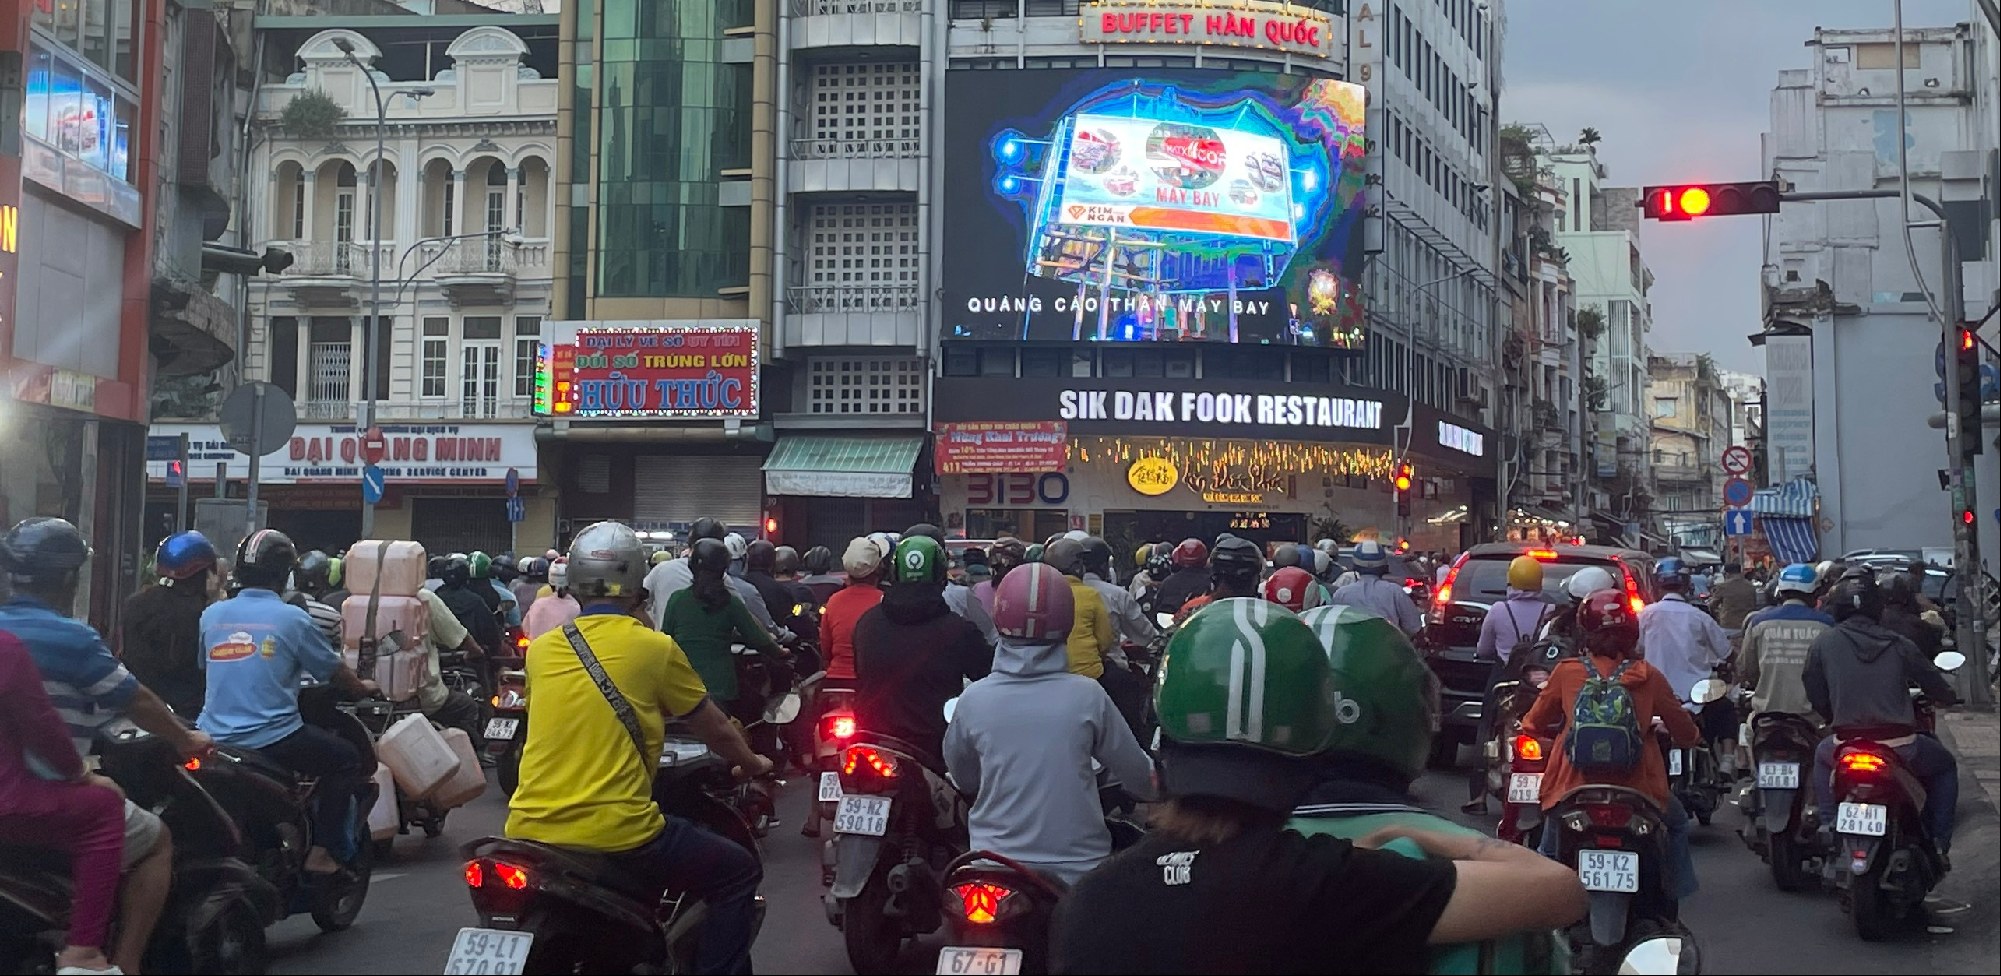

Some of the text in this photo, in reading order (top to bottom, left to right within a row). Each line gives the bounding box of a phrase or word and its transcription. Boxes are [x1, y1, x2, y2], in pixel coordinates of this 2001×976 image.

[1102, 11, 1320, 47] BUFFET HÀN QUỐC
[1193, 190, 1220, 207] BAY
[1089, 206, 1112, 214] KIM
[0, 205, 17, 253] N
[1054, 295, 1098, 312] CÁO
[1233, 300, 1270, 315] BAY
[688, 336, 709, 347] UY
[644, 351, 705, 368] TRÚNG
[711, 352, 747, 368] LỚN
[580, 370, 741, 410] HỮU THỨC
[1060, 390, 1382, 429] SIK DAK FOOK RESTAURANT
[435, 437, 501, 461] MINH
[407, 467, 446, 477] SERVICE
[449, 467, 487, 477] CENTER
[1589, 853, 1630, 871] 59-K2
[1583, 870, 1635, 889] 561.75
[464, 933, 519, 959] 59-L1
